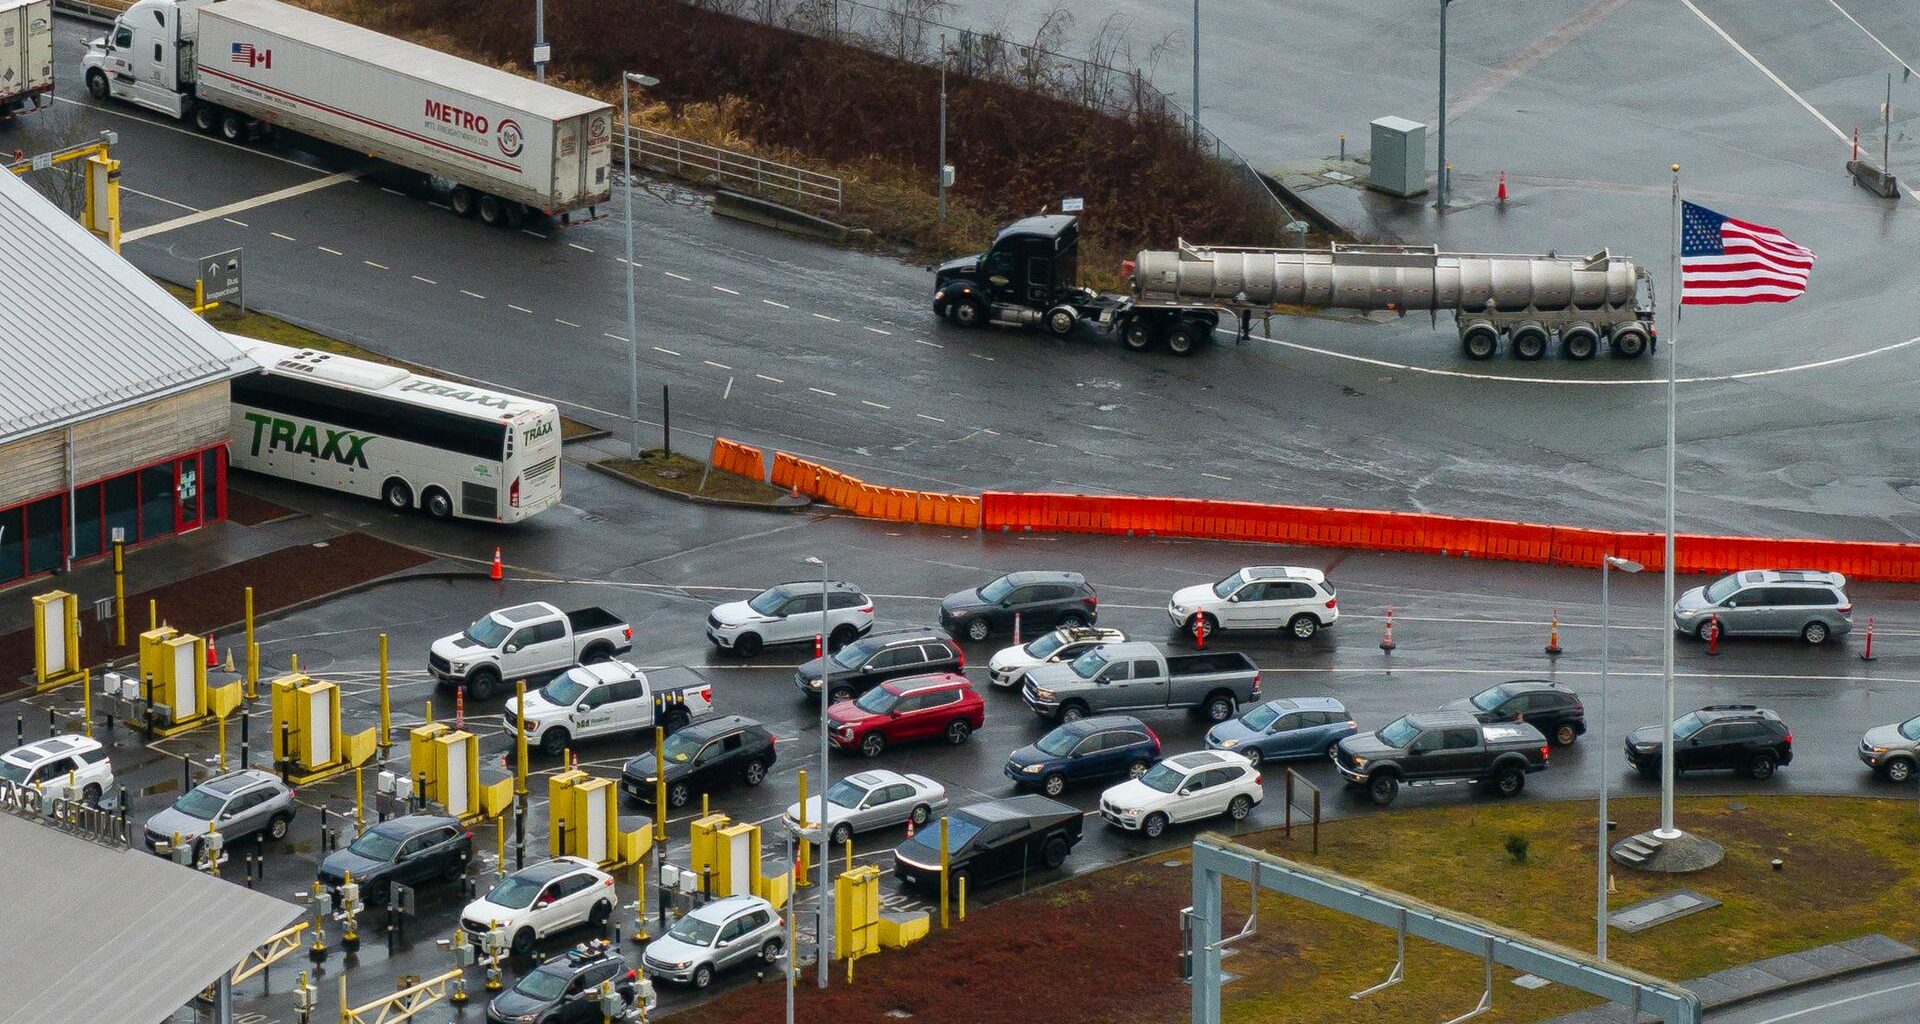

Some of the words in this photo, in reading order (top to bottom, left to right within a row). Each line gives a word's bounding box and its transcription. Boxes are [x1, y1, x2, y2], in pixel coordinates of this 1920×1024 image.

[424, 98, 489, 134] METRO
[226, 278, 239, 286] Bus
[399, 379, 518, 410] TRAXX
[244, 411, 379, 471] TRAXX
[522, 420, 554, 447] TRAXX
